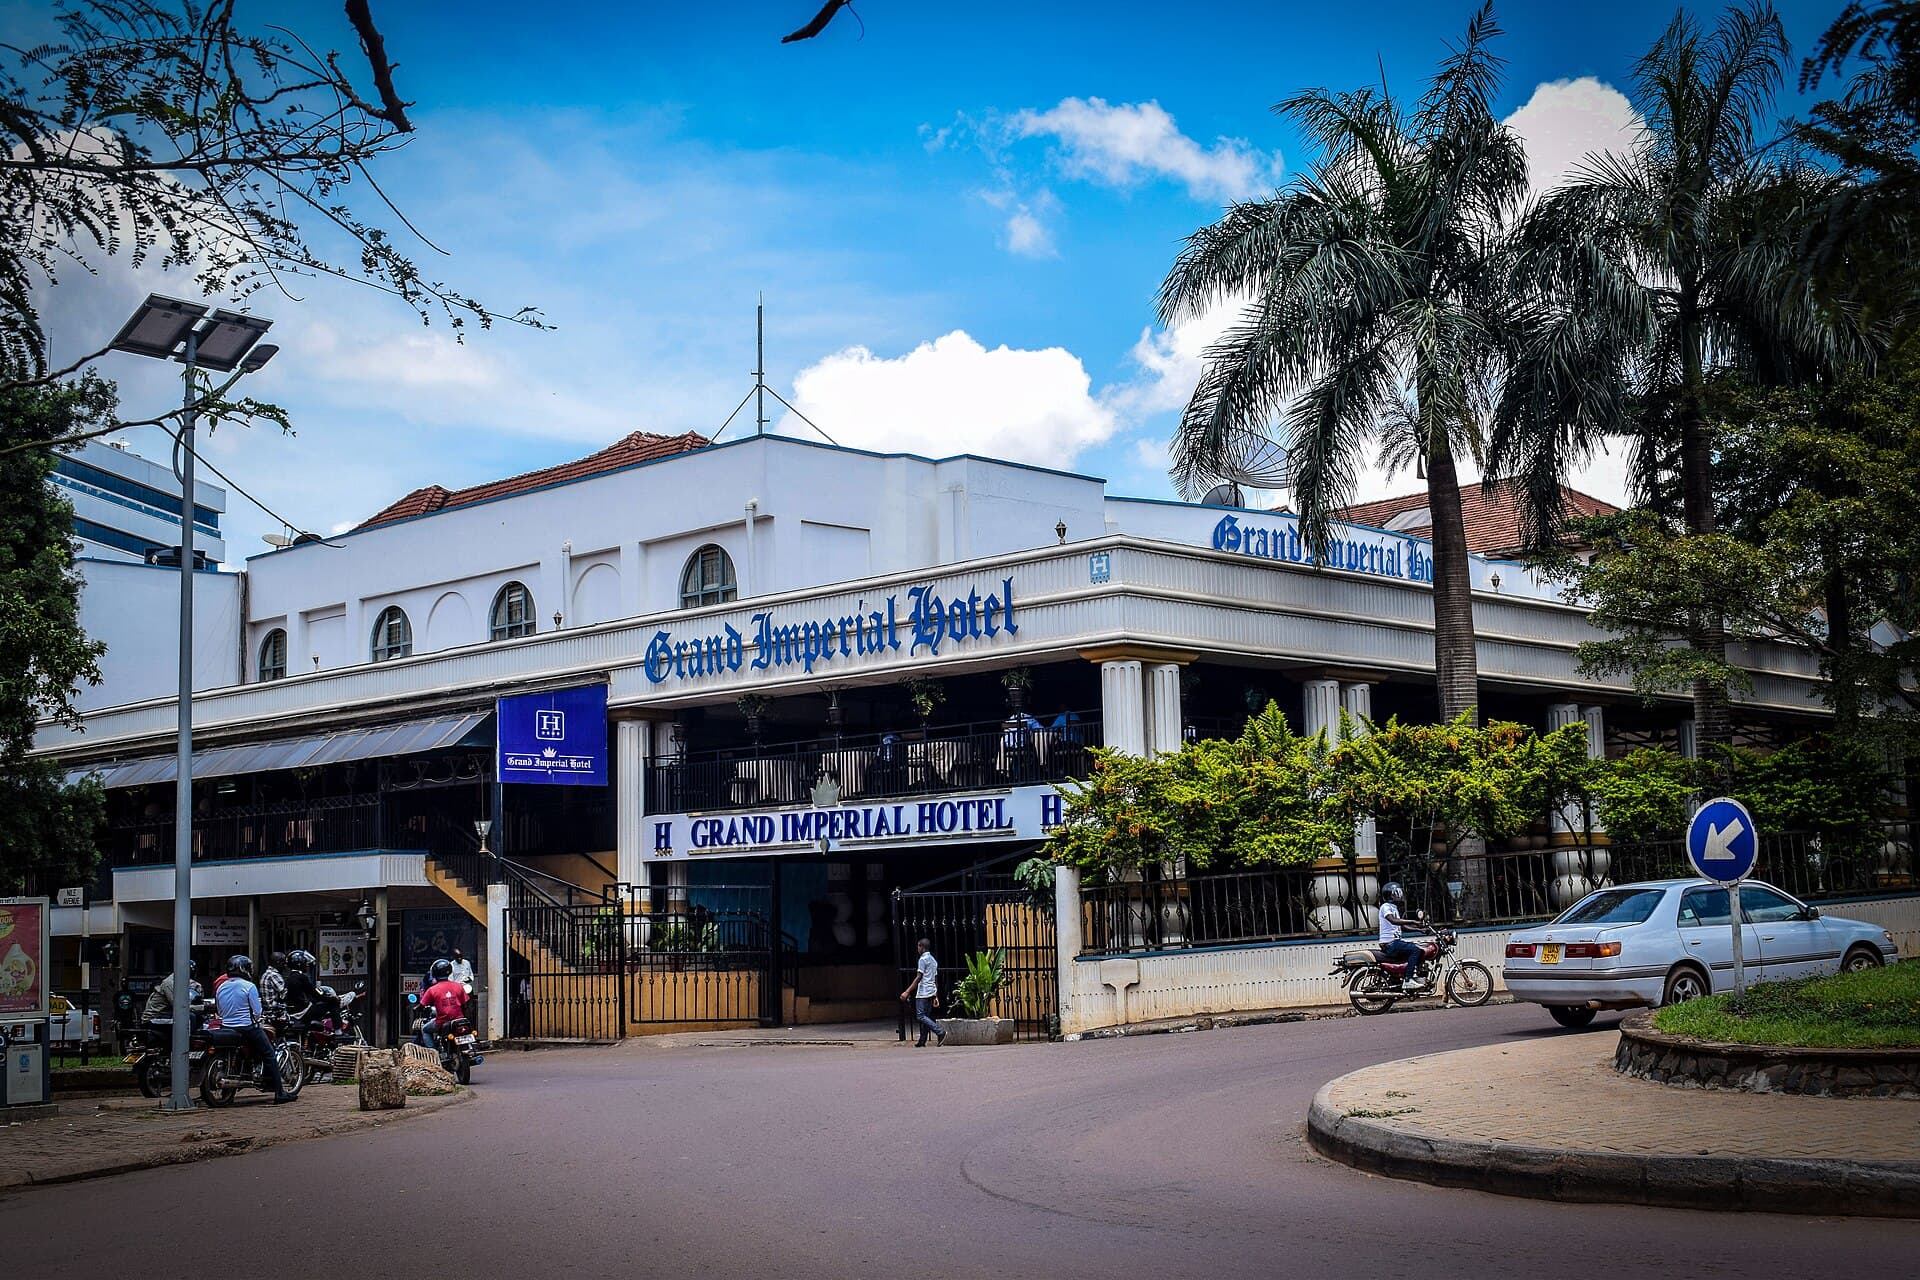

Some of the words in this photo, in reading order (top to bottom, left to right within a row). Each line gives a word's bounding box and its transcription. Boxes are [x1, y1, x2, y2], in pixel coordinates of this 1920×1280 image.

[1213, 514, 1301, 562] Grand
[1304, 536, 1403, 578] mperial
[644, 621, 743, 684] Grand
[750, 594, 901, 674] Imperial
[907, 575, 1020, 657] Hotel
[540, 715, 561, 731] H
[507, 756, 533, 767] Grand
[534, 758, 568, 769] Imperial
[570, 758, 591, 770] Hotel
[1040, 794, 1064, 826] H
[655, 822, 672, 850] H
[690, 815, 776, 849] GRAND
[780, 806, 911, 842] IMPERIAL
[916, 798, 1014, 833] HOTEL
[66, 889, 76, 897] NILE
[63, 897, 80, 905] AVENUE
[404, 981, 418, 992] SHOP
[49, 1001, 66, 1010] AD
